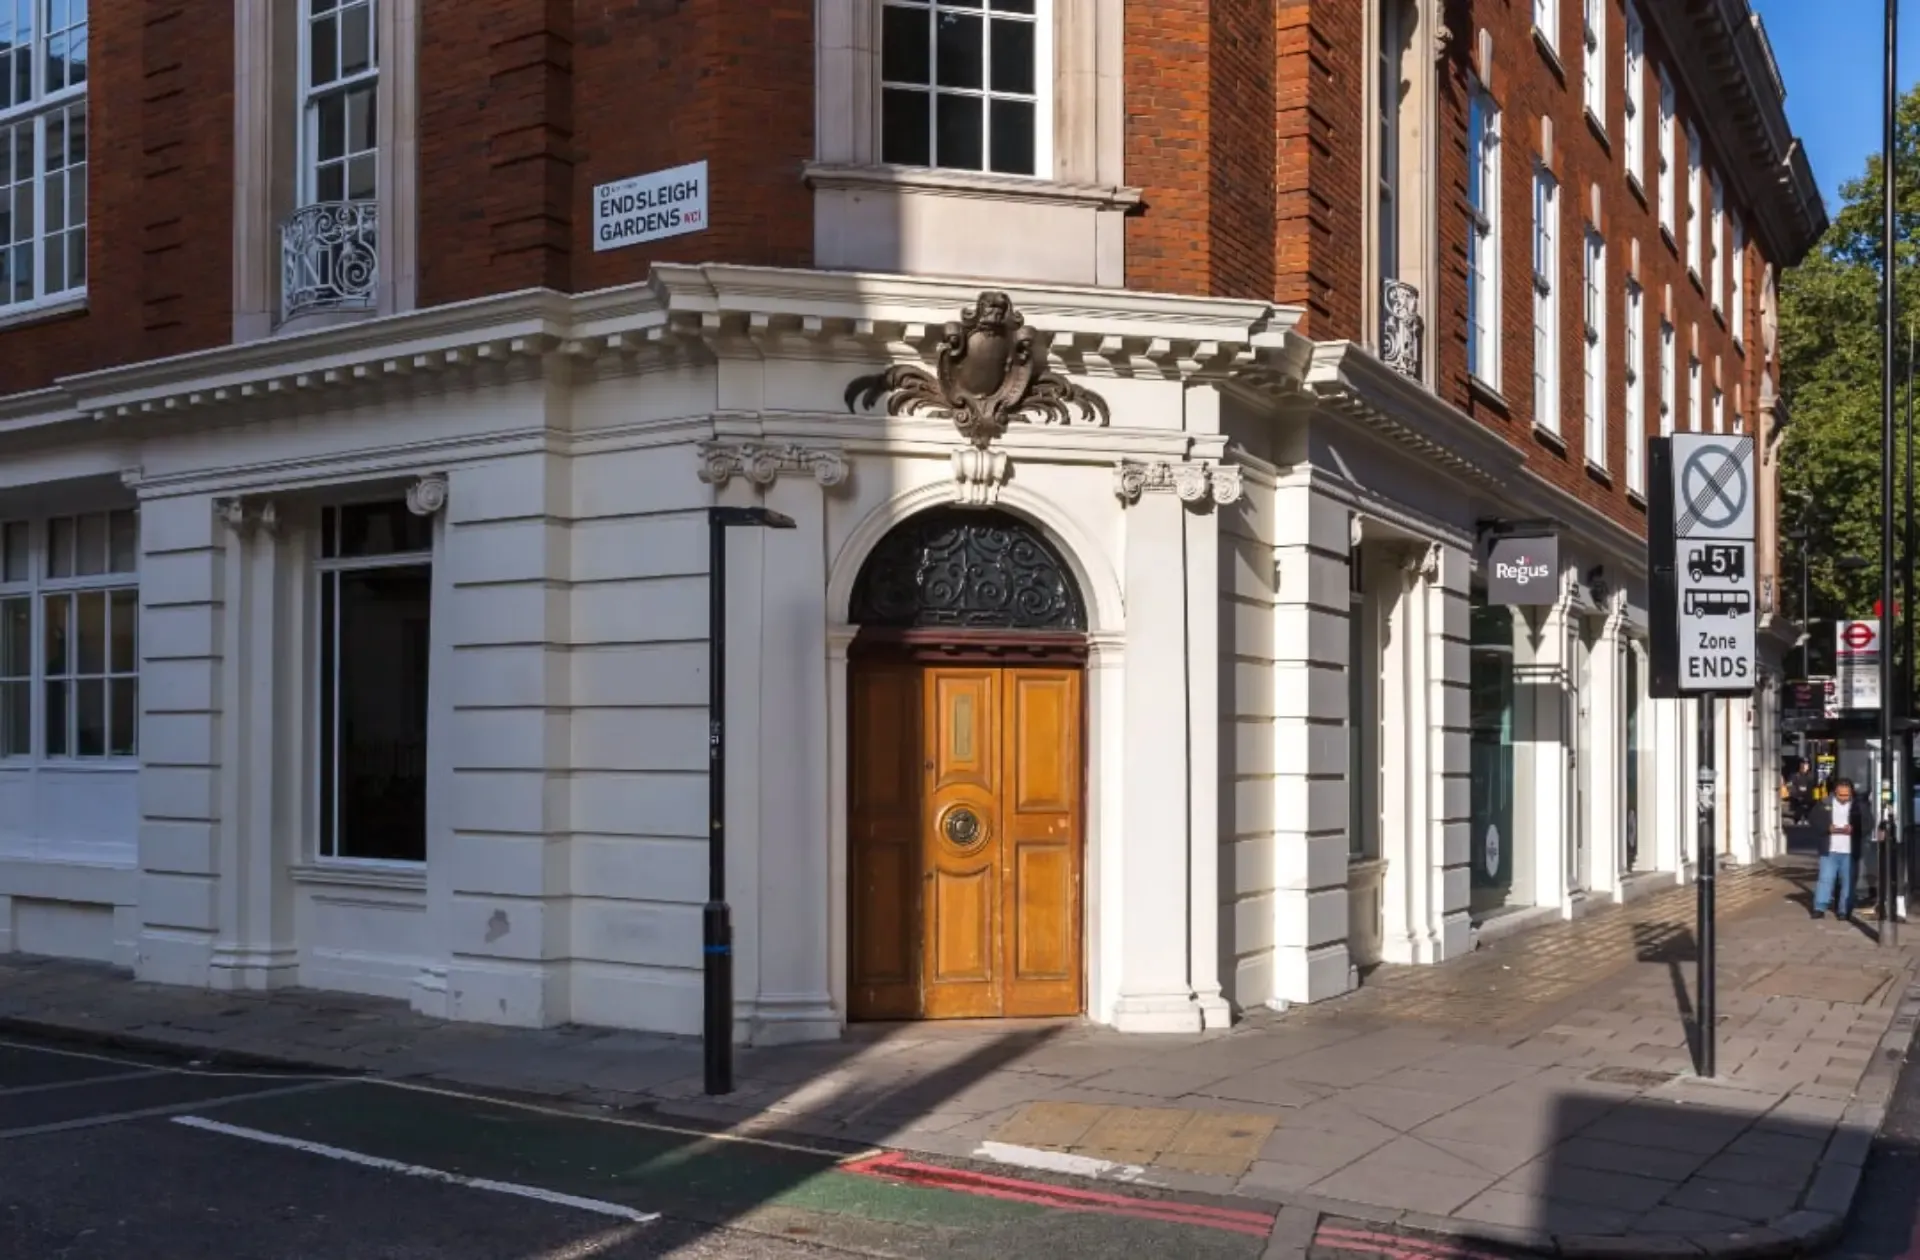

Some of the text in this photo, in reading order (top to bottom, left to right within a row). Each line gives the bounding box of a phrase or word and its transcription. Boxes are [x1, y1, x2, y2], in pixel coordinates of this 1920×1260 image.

[601, 180, 698, 218] ENDSLEIGH
[600, 208, 681, 242] GARDENS
[1496, 562, 1549, 585] Regus
[1698, 631, 1737, 650] Zone
[1688, 656, 1748, 678] ENDS
